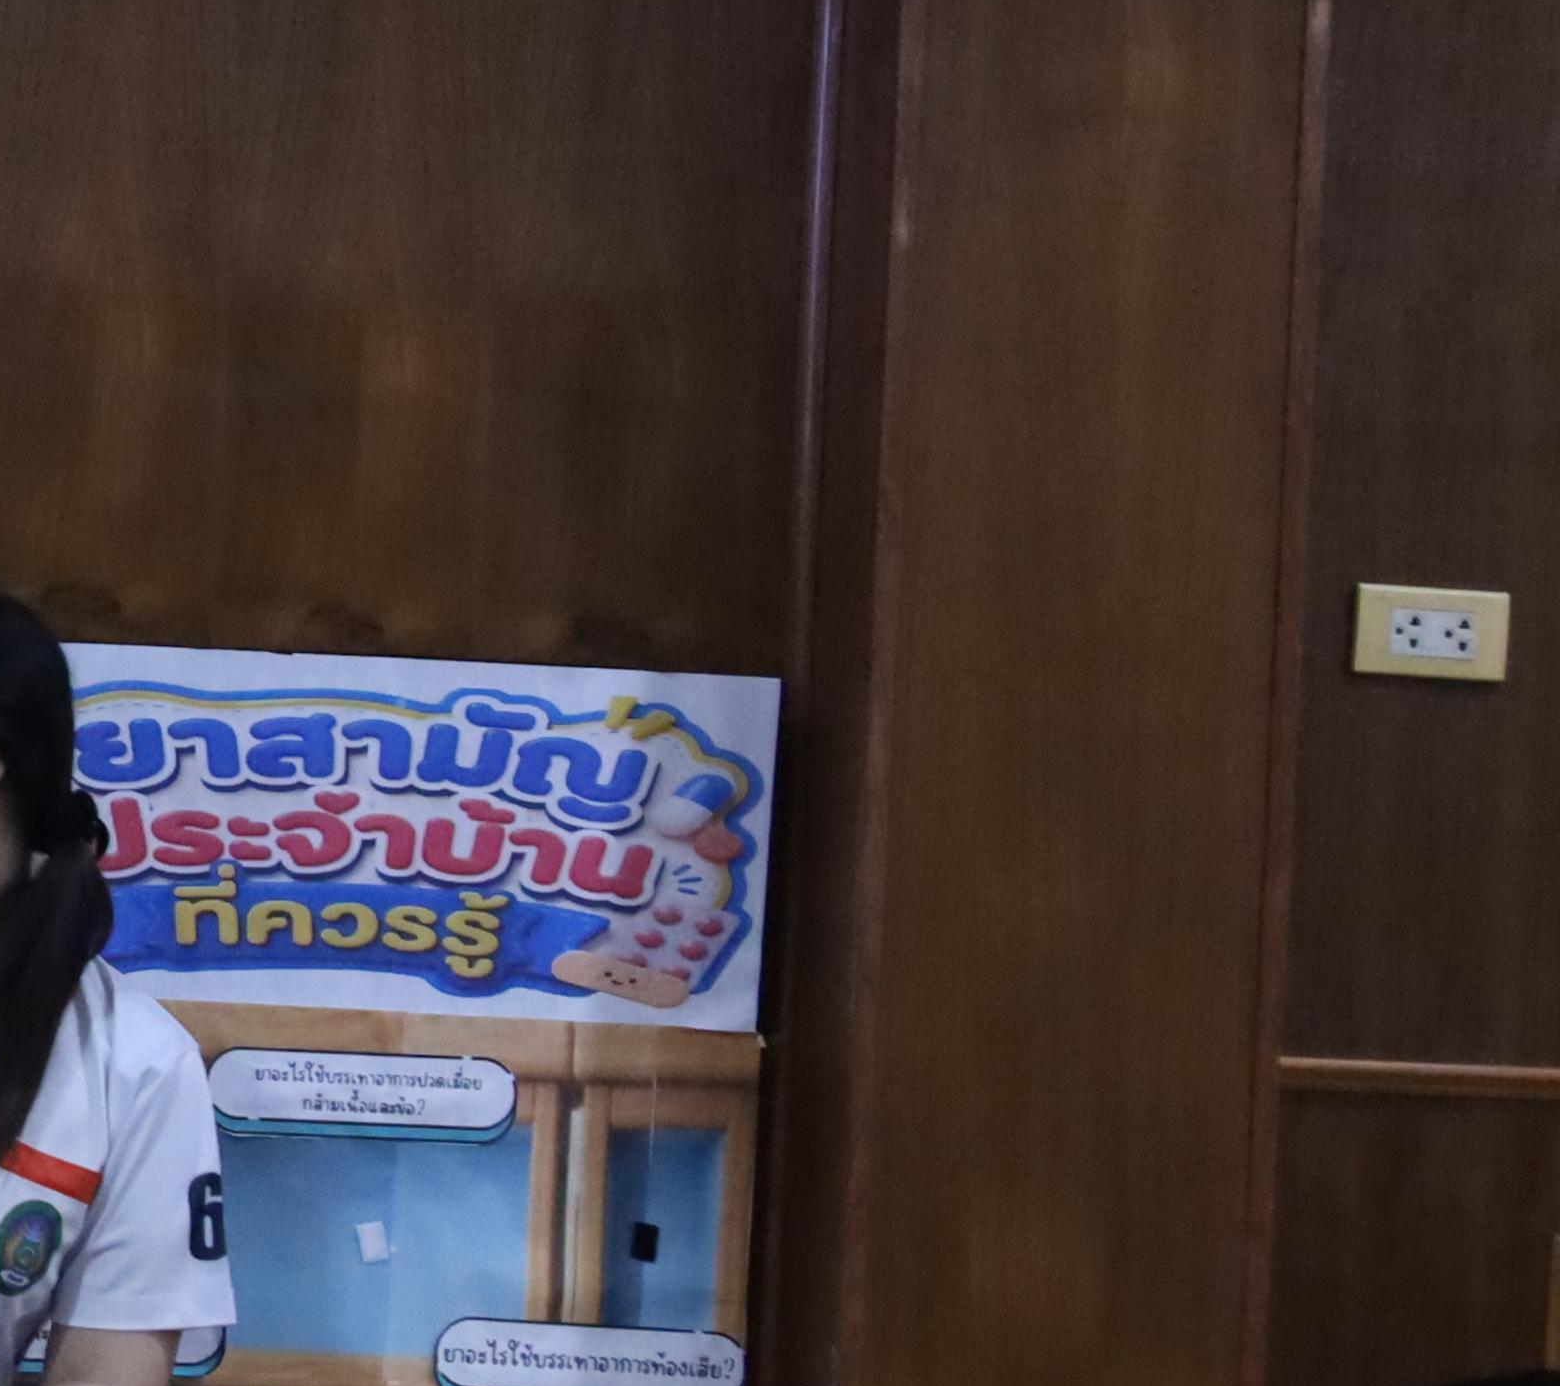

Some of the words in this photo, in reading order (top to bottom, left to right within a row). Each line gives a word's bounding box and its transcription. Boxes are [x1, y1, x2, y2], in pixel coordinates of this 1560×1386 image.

[76, 703, 647, 824] ยาสามัญ
[172, 863, 508, 979] ที่ควรรู้
[189, 1173, 226, 1261] 6
